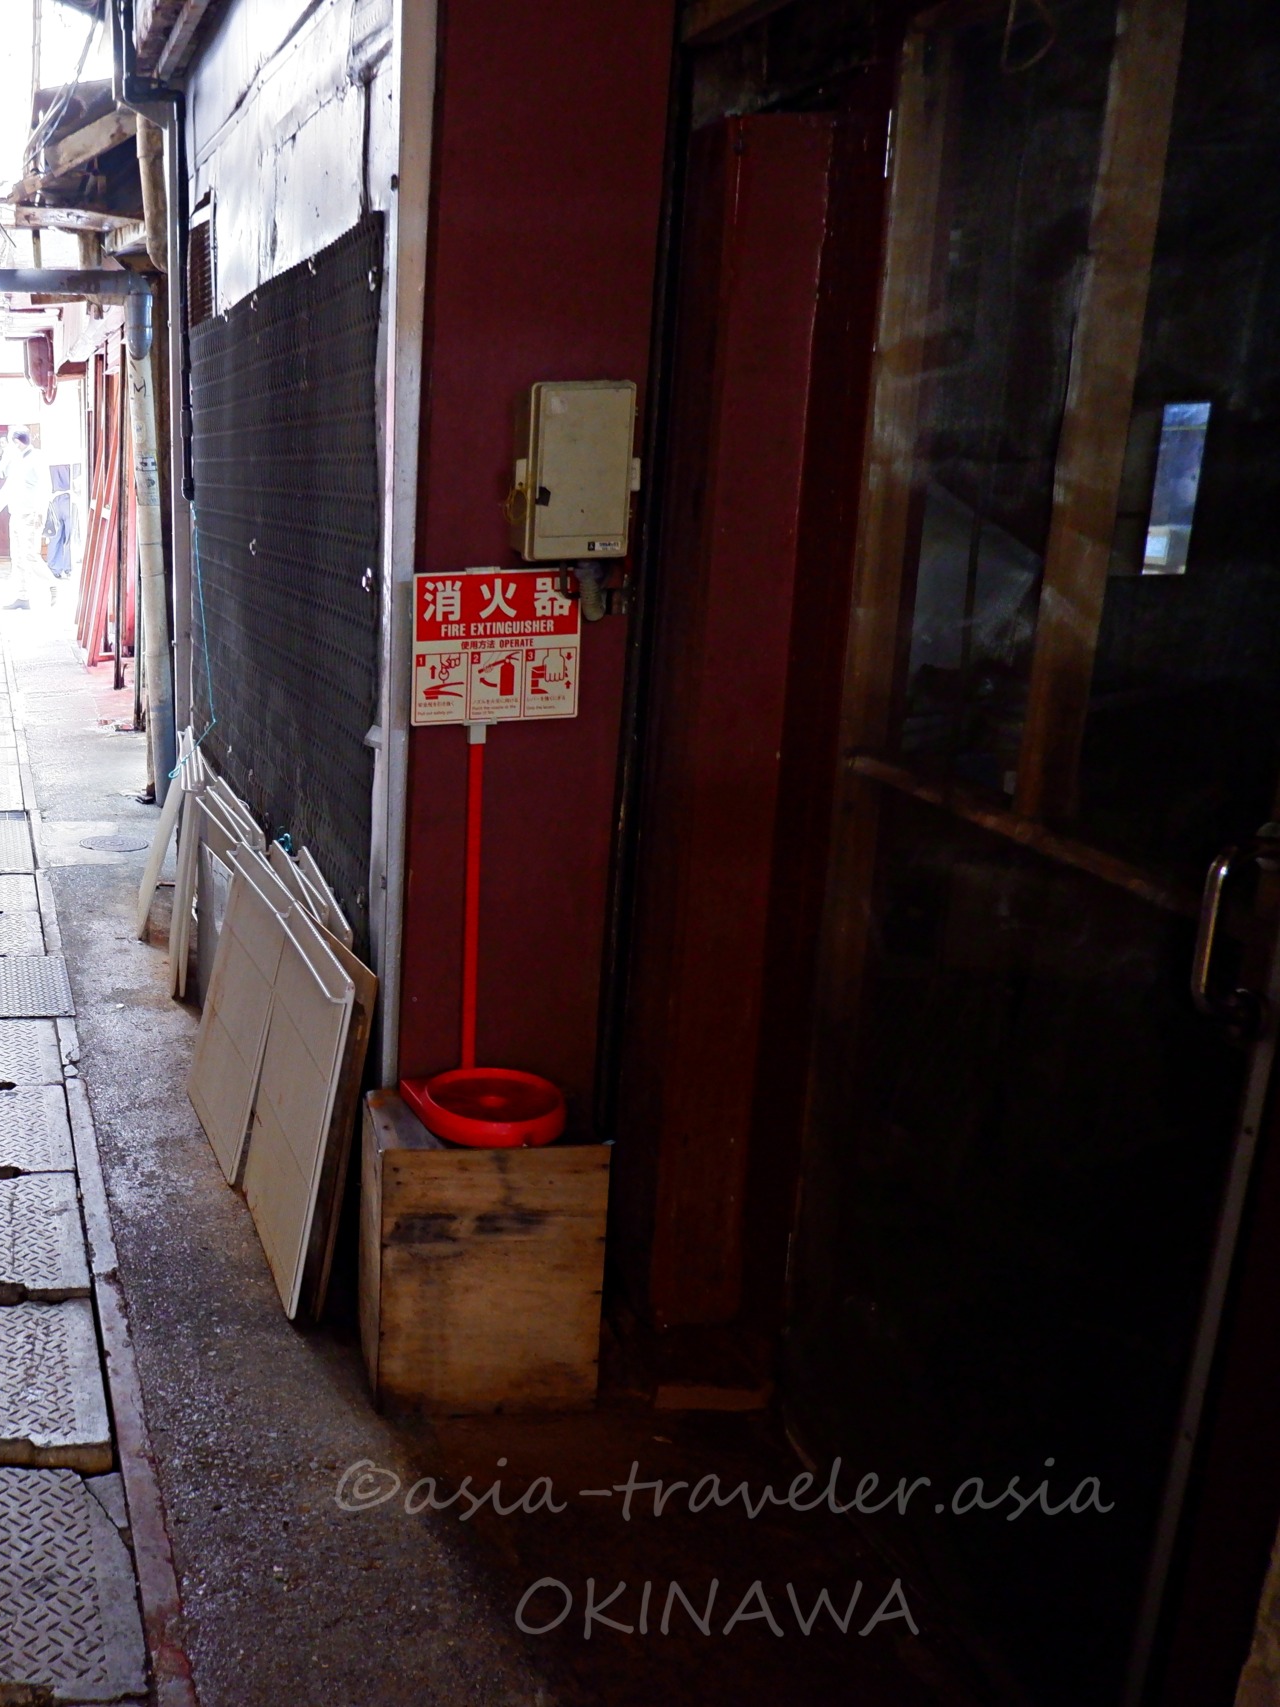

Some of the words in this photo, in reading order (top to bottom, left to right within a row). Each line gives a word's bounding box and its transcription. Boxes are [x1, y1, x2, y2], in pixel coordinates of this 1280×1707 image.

[423, 577, 572, 622] 消火器
[440, 623, 466, 637] FIRE
[470, 620, 555, 636] EXTINGUISHER
[461, 639, 495, 650] 使用方法
[499, 638, 534, 648] OPERATE
[473, 654, 479, 662] 2
[527, 651, 534, 660] 3
